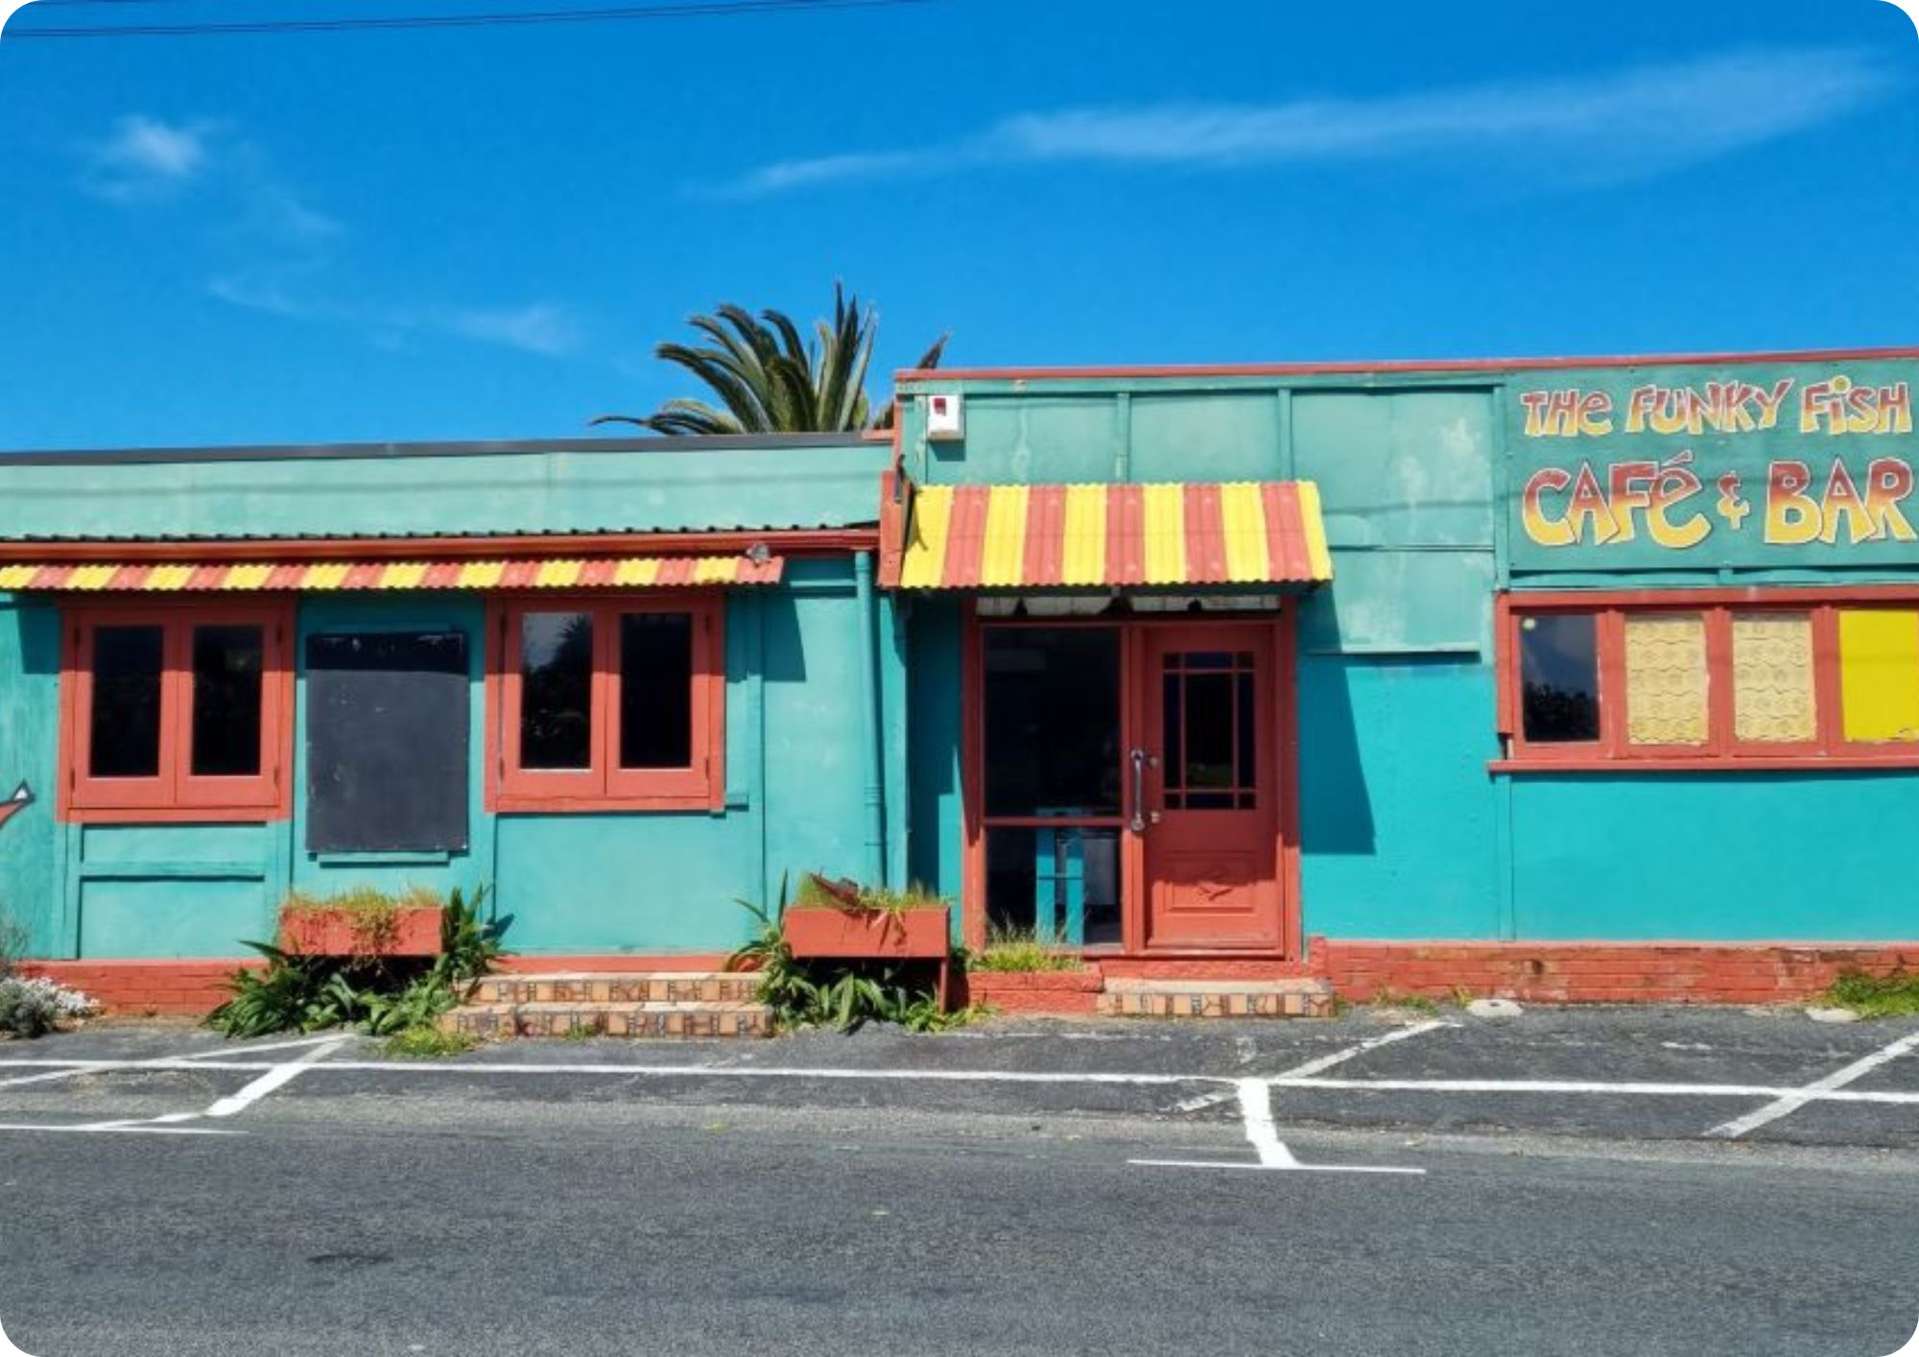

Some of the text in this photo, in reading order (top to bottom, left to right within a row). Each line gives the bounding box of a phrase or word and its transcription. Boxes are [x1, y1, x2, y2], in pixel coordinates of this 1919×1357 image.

[1624, 378, 1796, 434] FUNKY
[1716, 470, 1750, 530] &
[1764, 456, 1918, 545] BAR
